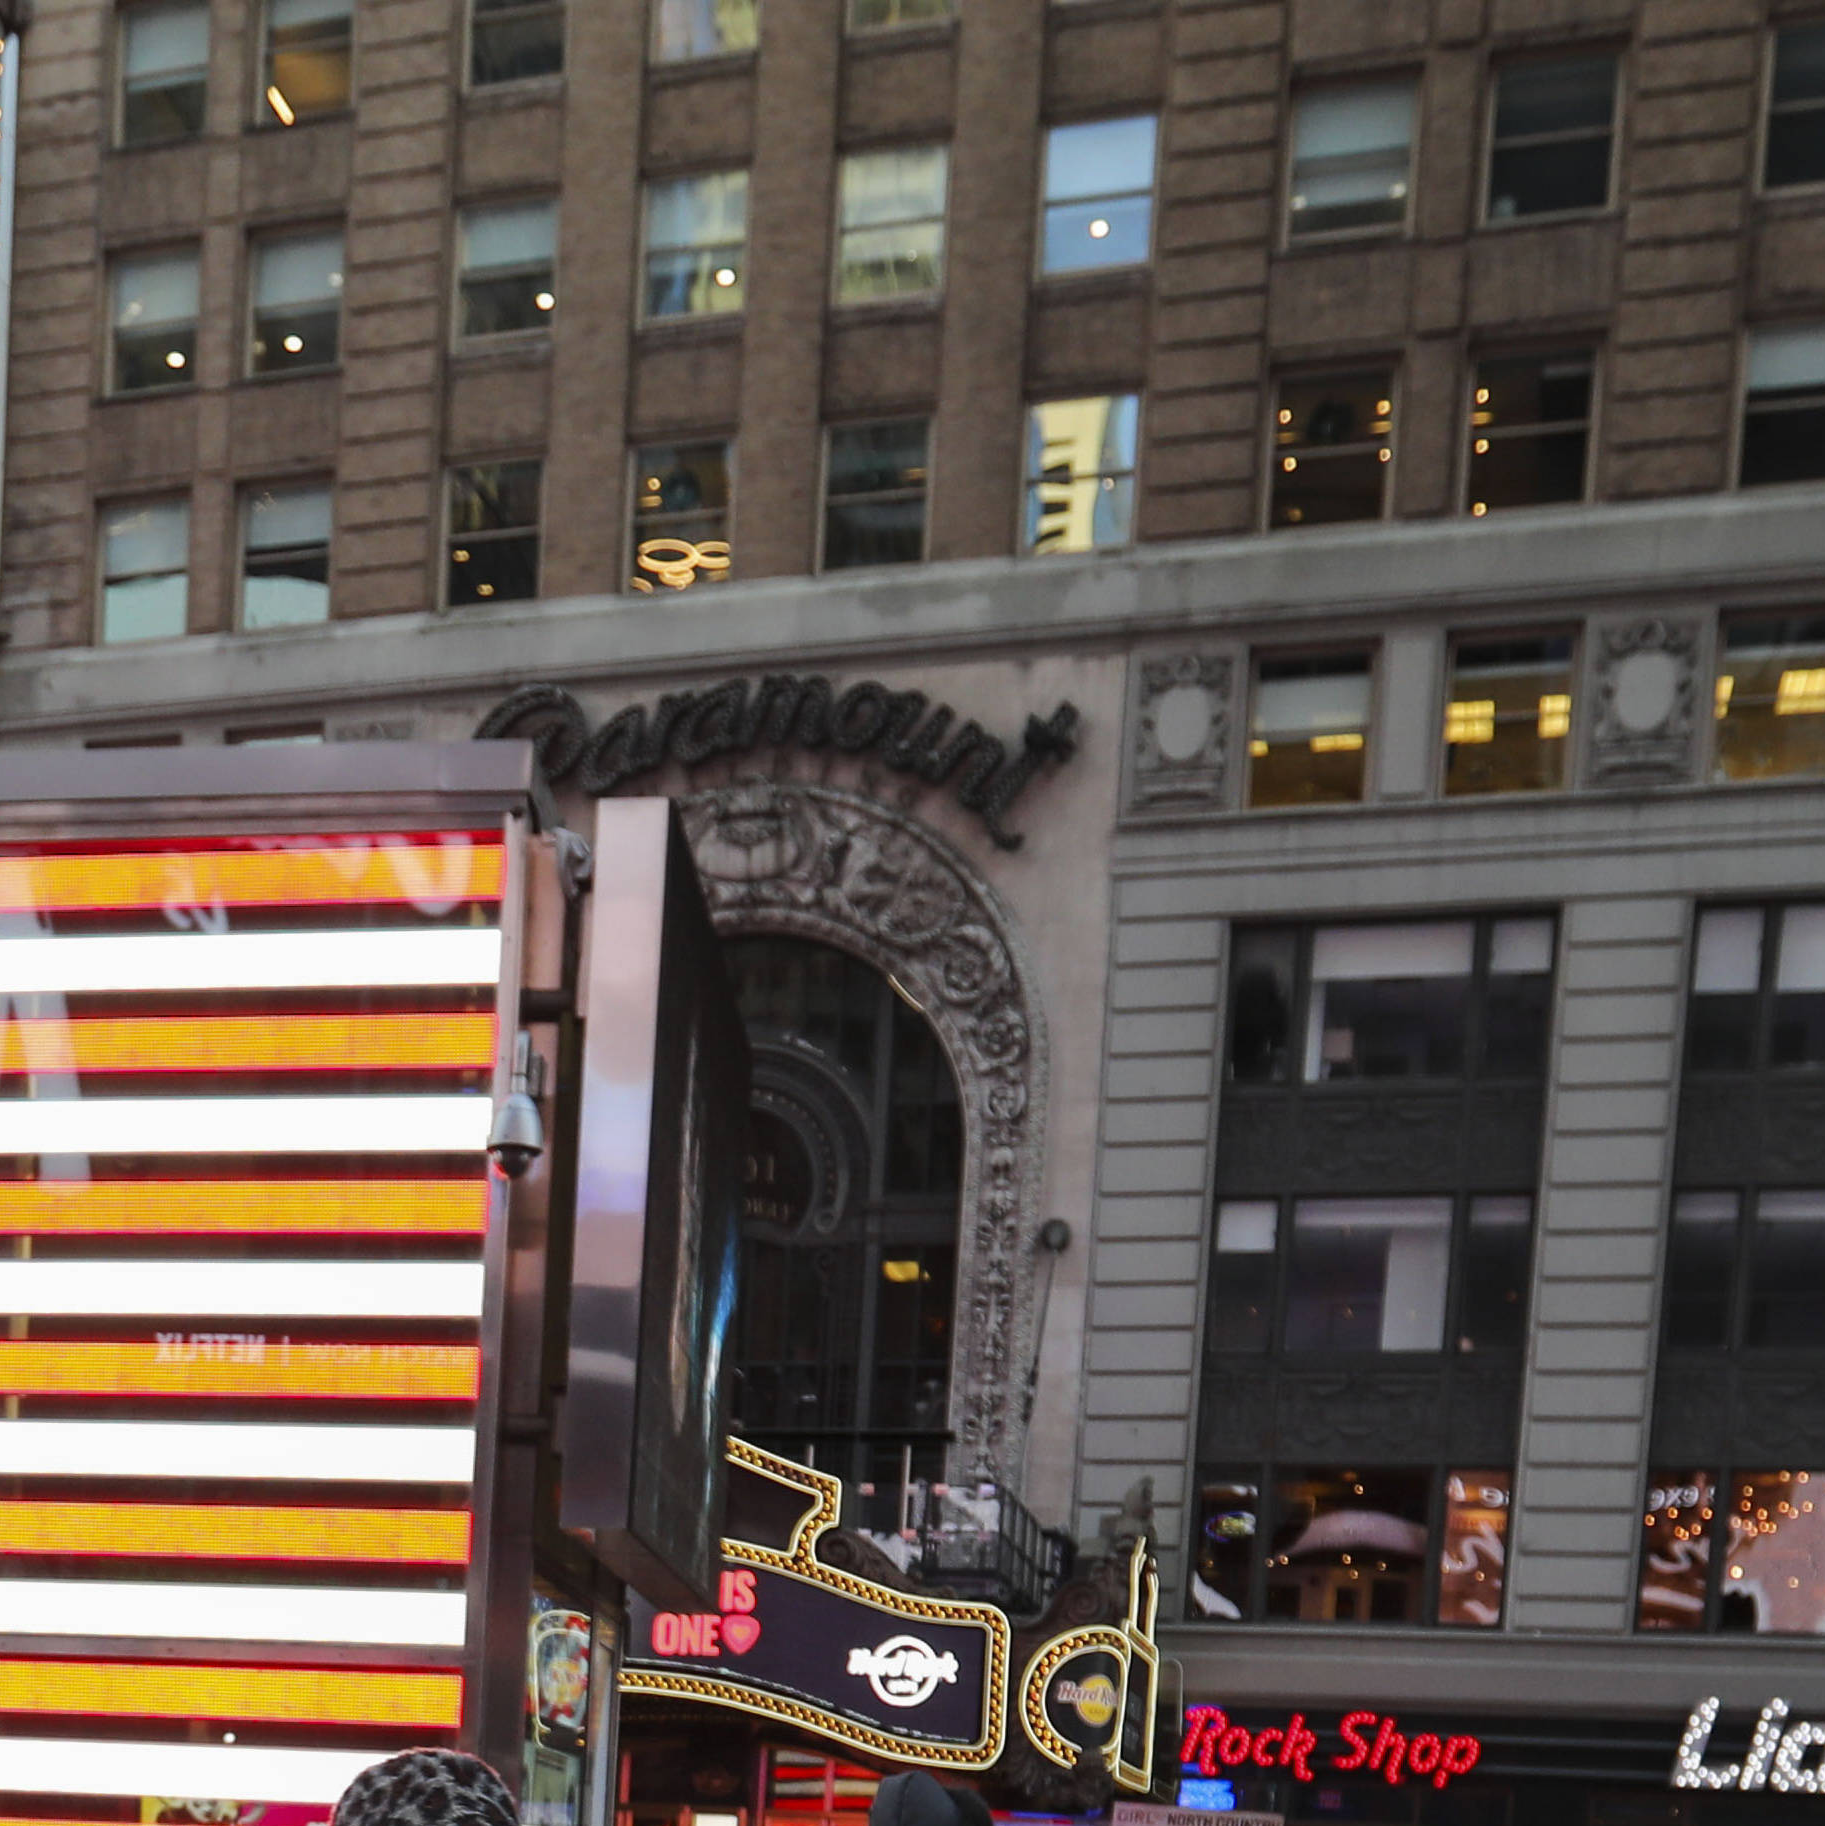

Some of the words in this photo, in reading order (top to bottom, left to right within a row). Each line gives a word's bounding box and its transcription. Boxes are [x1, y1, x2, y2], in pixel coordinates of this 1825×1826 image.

[719, 1569, 757, 1613] IS
[651, 1611, 722, 1657] ONE
[1179, 1705, 1317, 1782] Rock
[1333, 1710, 1481, 1789] Shop
